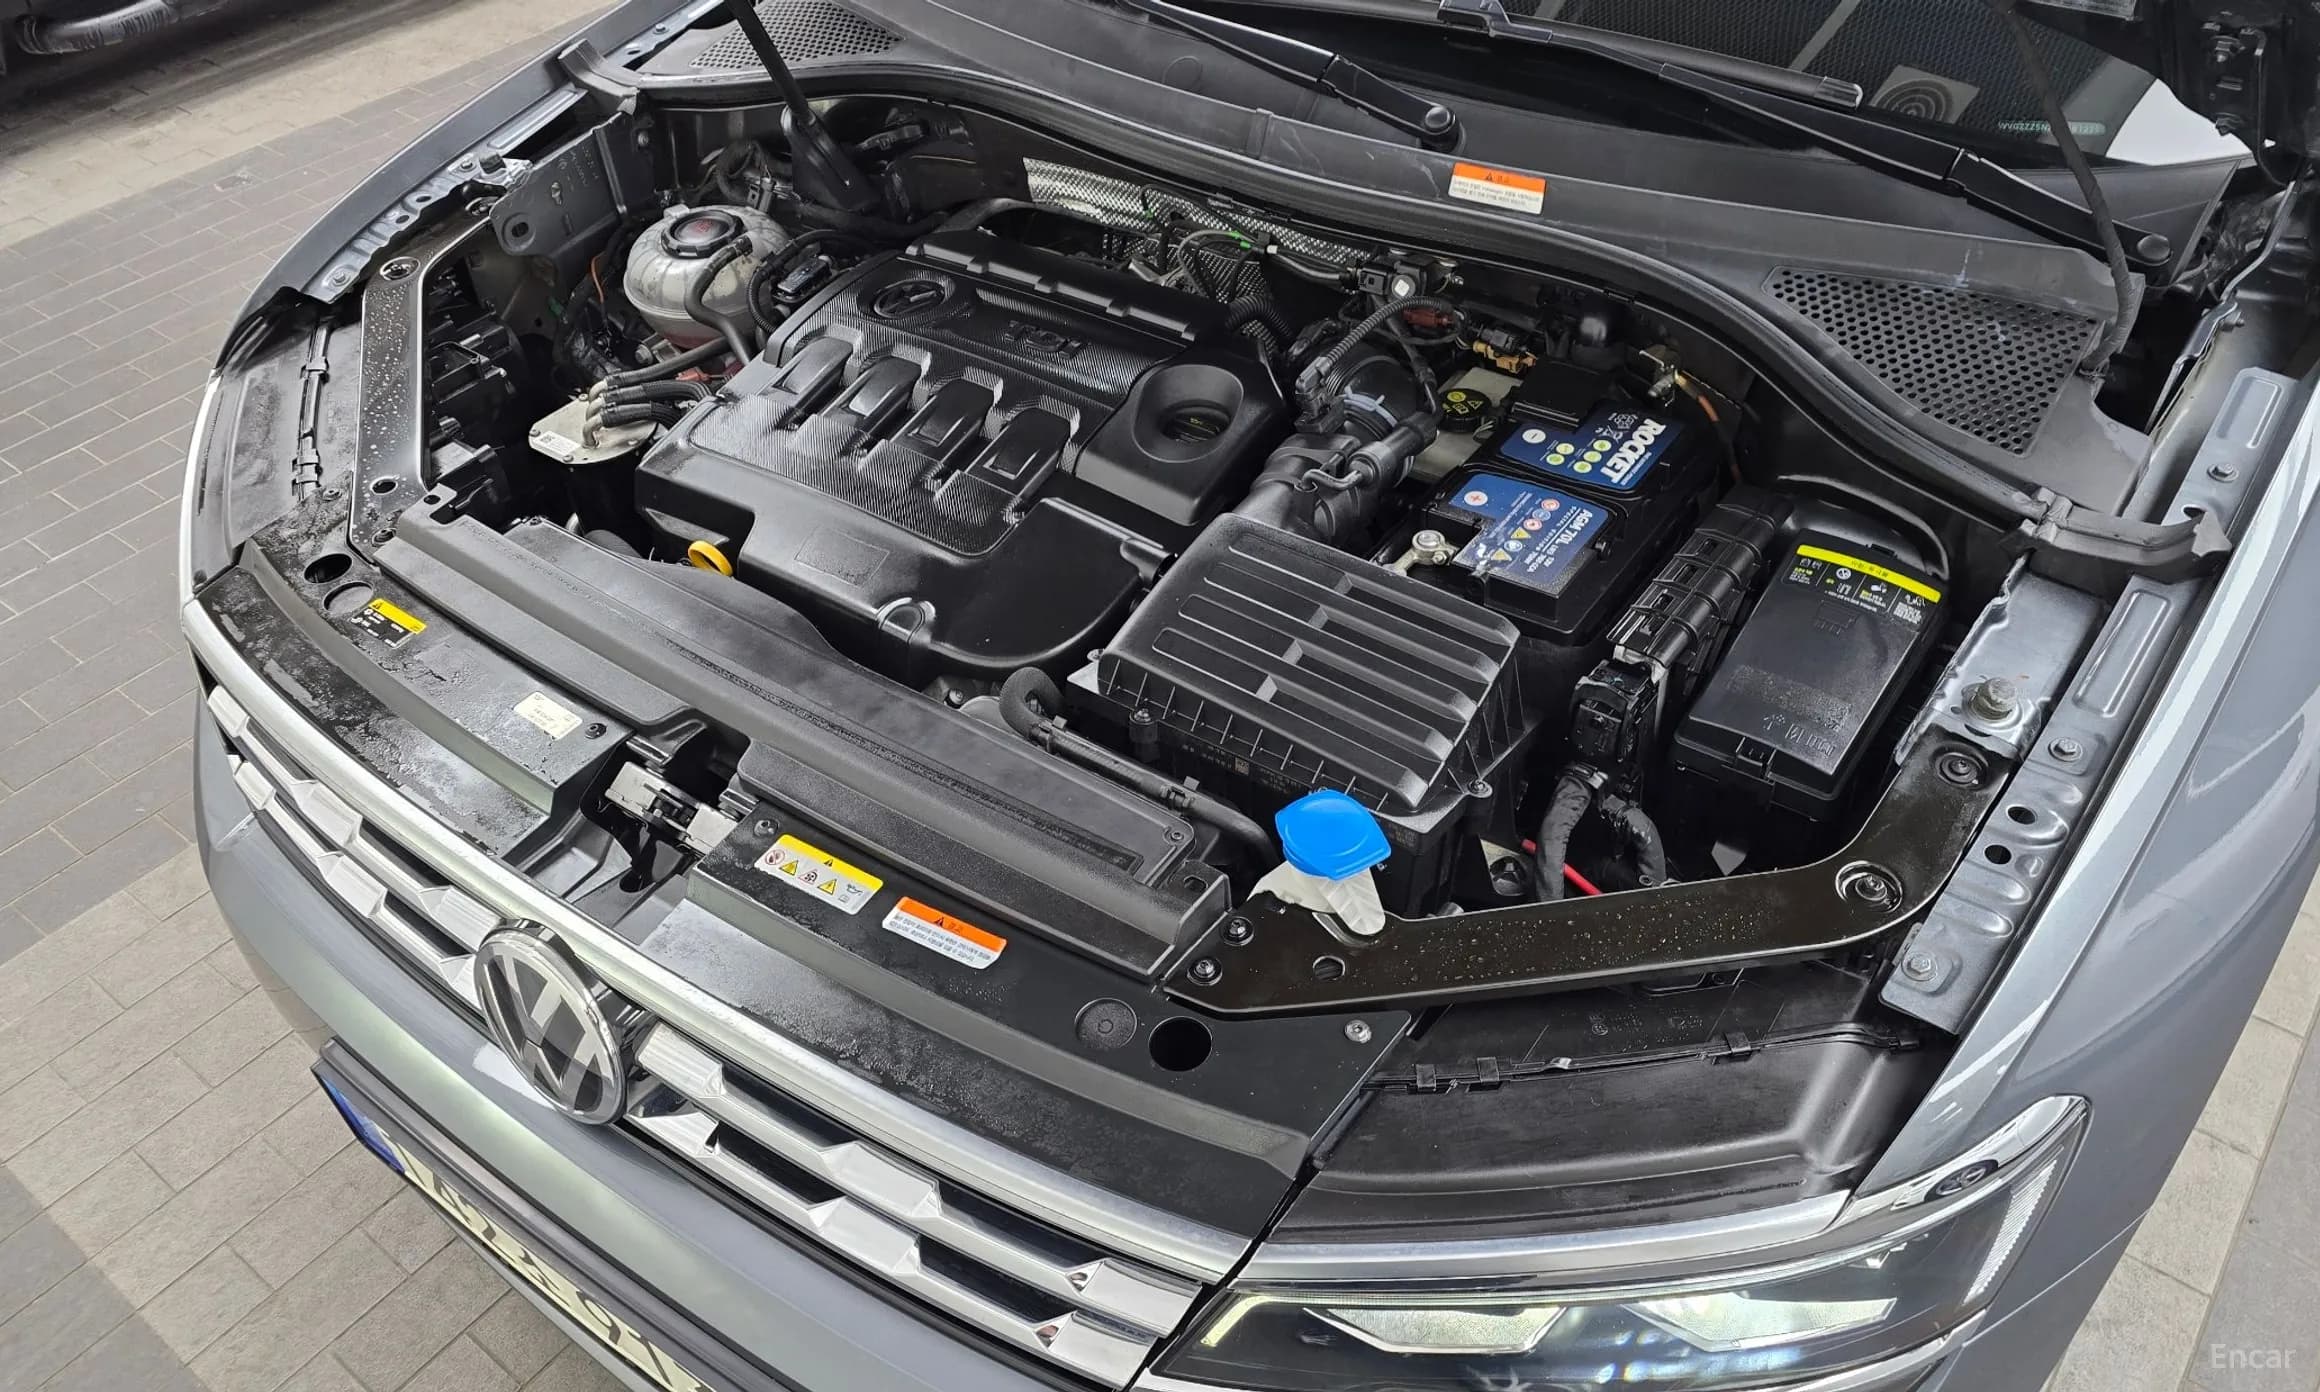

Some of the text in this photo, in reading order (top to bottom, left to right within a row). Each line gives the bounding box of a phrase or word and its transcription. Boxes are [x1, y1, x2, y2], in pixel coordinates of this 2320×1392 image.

[1600, 418, 1667, 484] ROCKET
[1569, 508, 1593, 531] AGM
[1555, 529, 1578, 545] 70L
